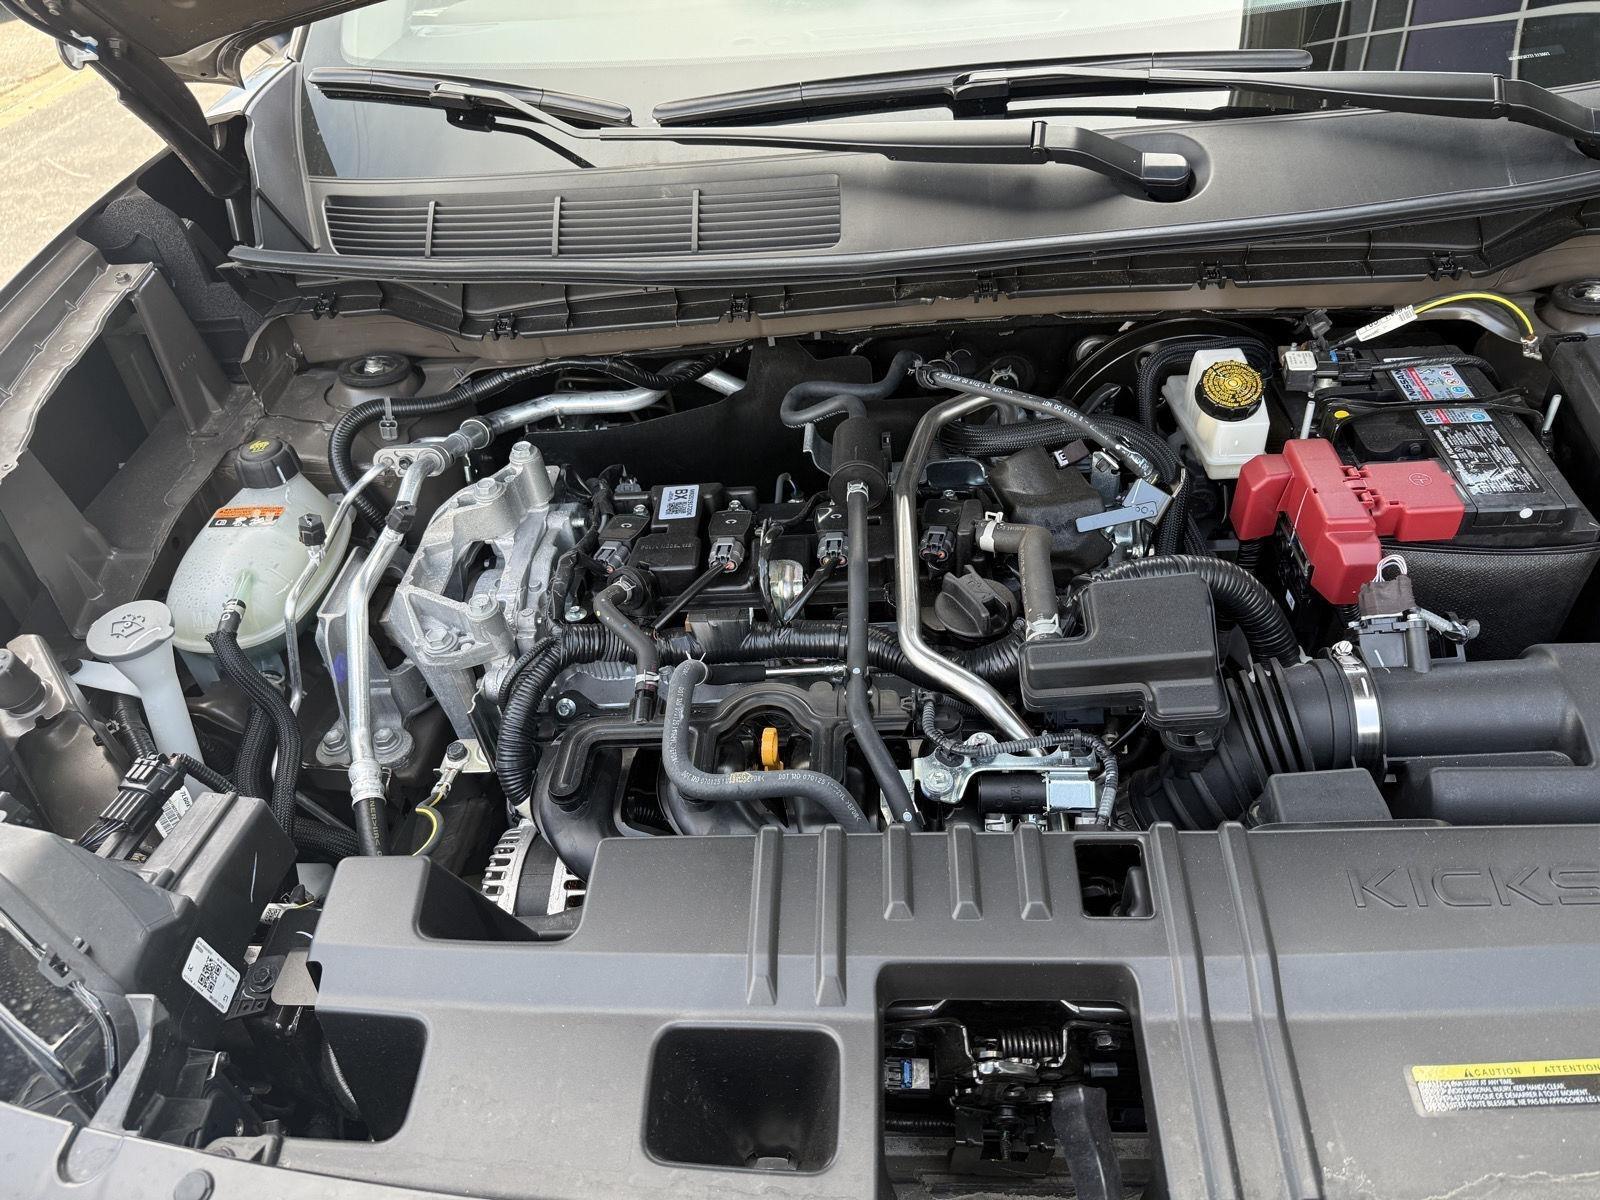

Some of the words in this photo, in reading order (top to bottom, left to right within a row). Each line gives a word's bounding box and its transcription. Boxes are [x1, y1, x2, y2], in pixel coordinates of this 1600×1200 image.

[674, 488, 688, 501] BX
[1346, 866, 1600, 909] KICKS
[1475, 1067, 1521, 1077] CAUTION
[1544, 1063, 1600, 1073] ATTENTION
